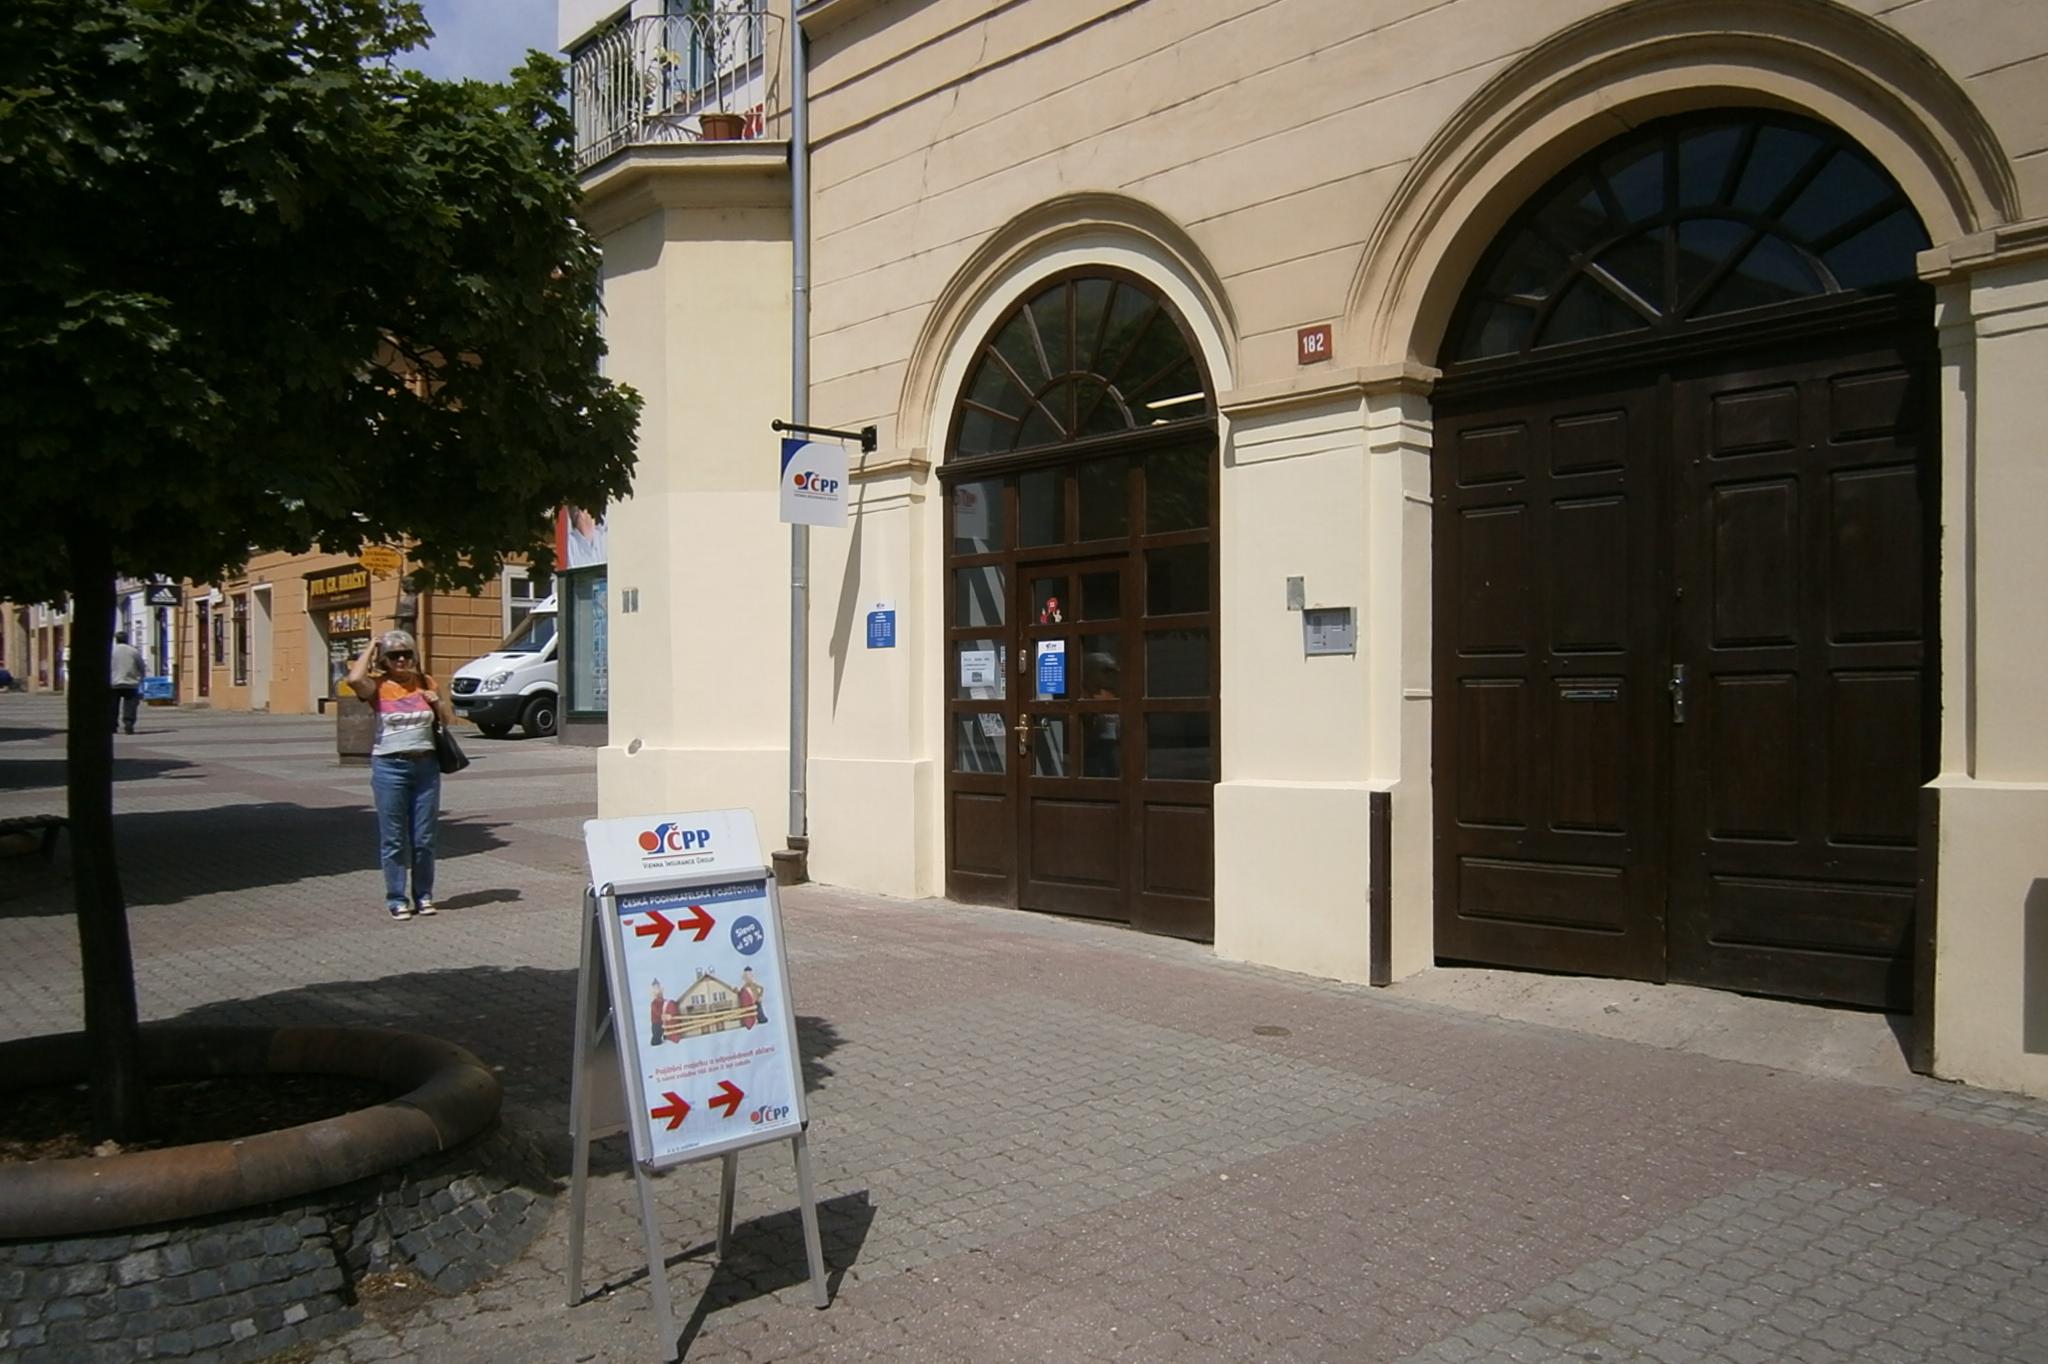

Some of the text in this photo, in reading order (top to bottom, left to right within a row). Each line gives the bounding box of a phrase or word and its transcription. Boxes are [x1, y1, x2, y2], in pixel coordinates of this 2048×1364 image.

[1303, 333, 1324, 354] 182
[810, 474, 839, 493] ČPP
[667, 825, 711, 851] ČPP
[765, 1106, 789, 1121] ČPP
